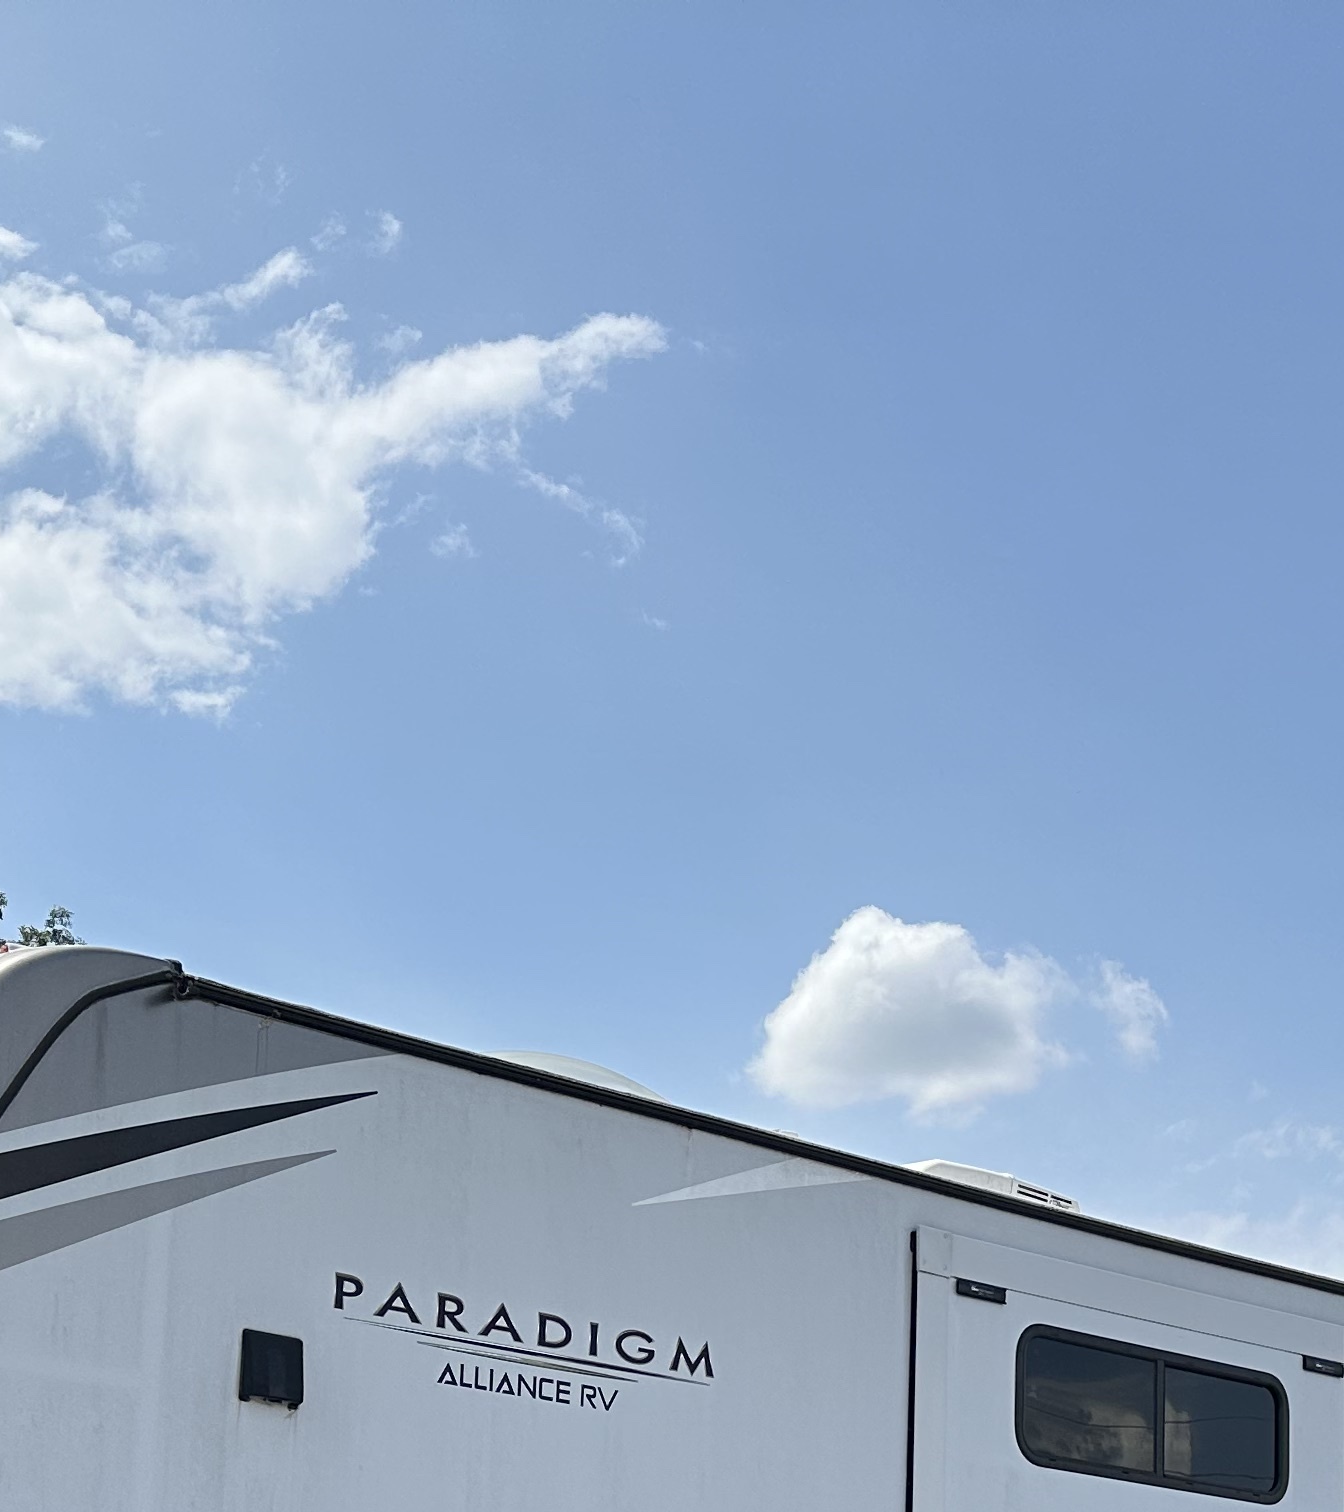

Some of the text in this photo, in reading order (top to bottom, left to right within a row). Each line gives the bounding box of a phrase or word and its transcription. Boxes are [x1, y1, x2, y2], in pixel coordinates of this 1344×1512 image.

[333, 1271, 715, 1379] PARADIGM
[436, 1362, 619, 1412] ALLIANCE RV
